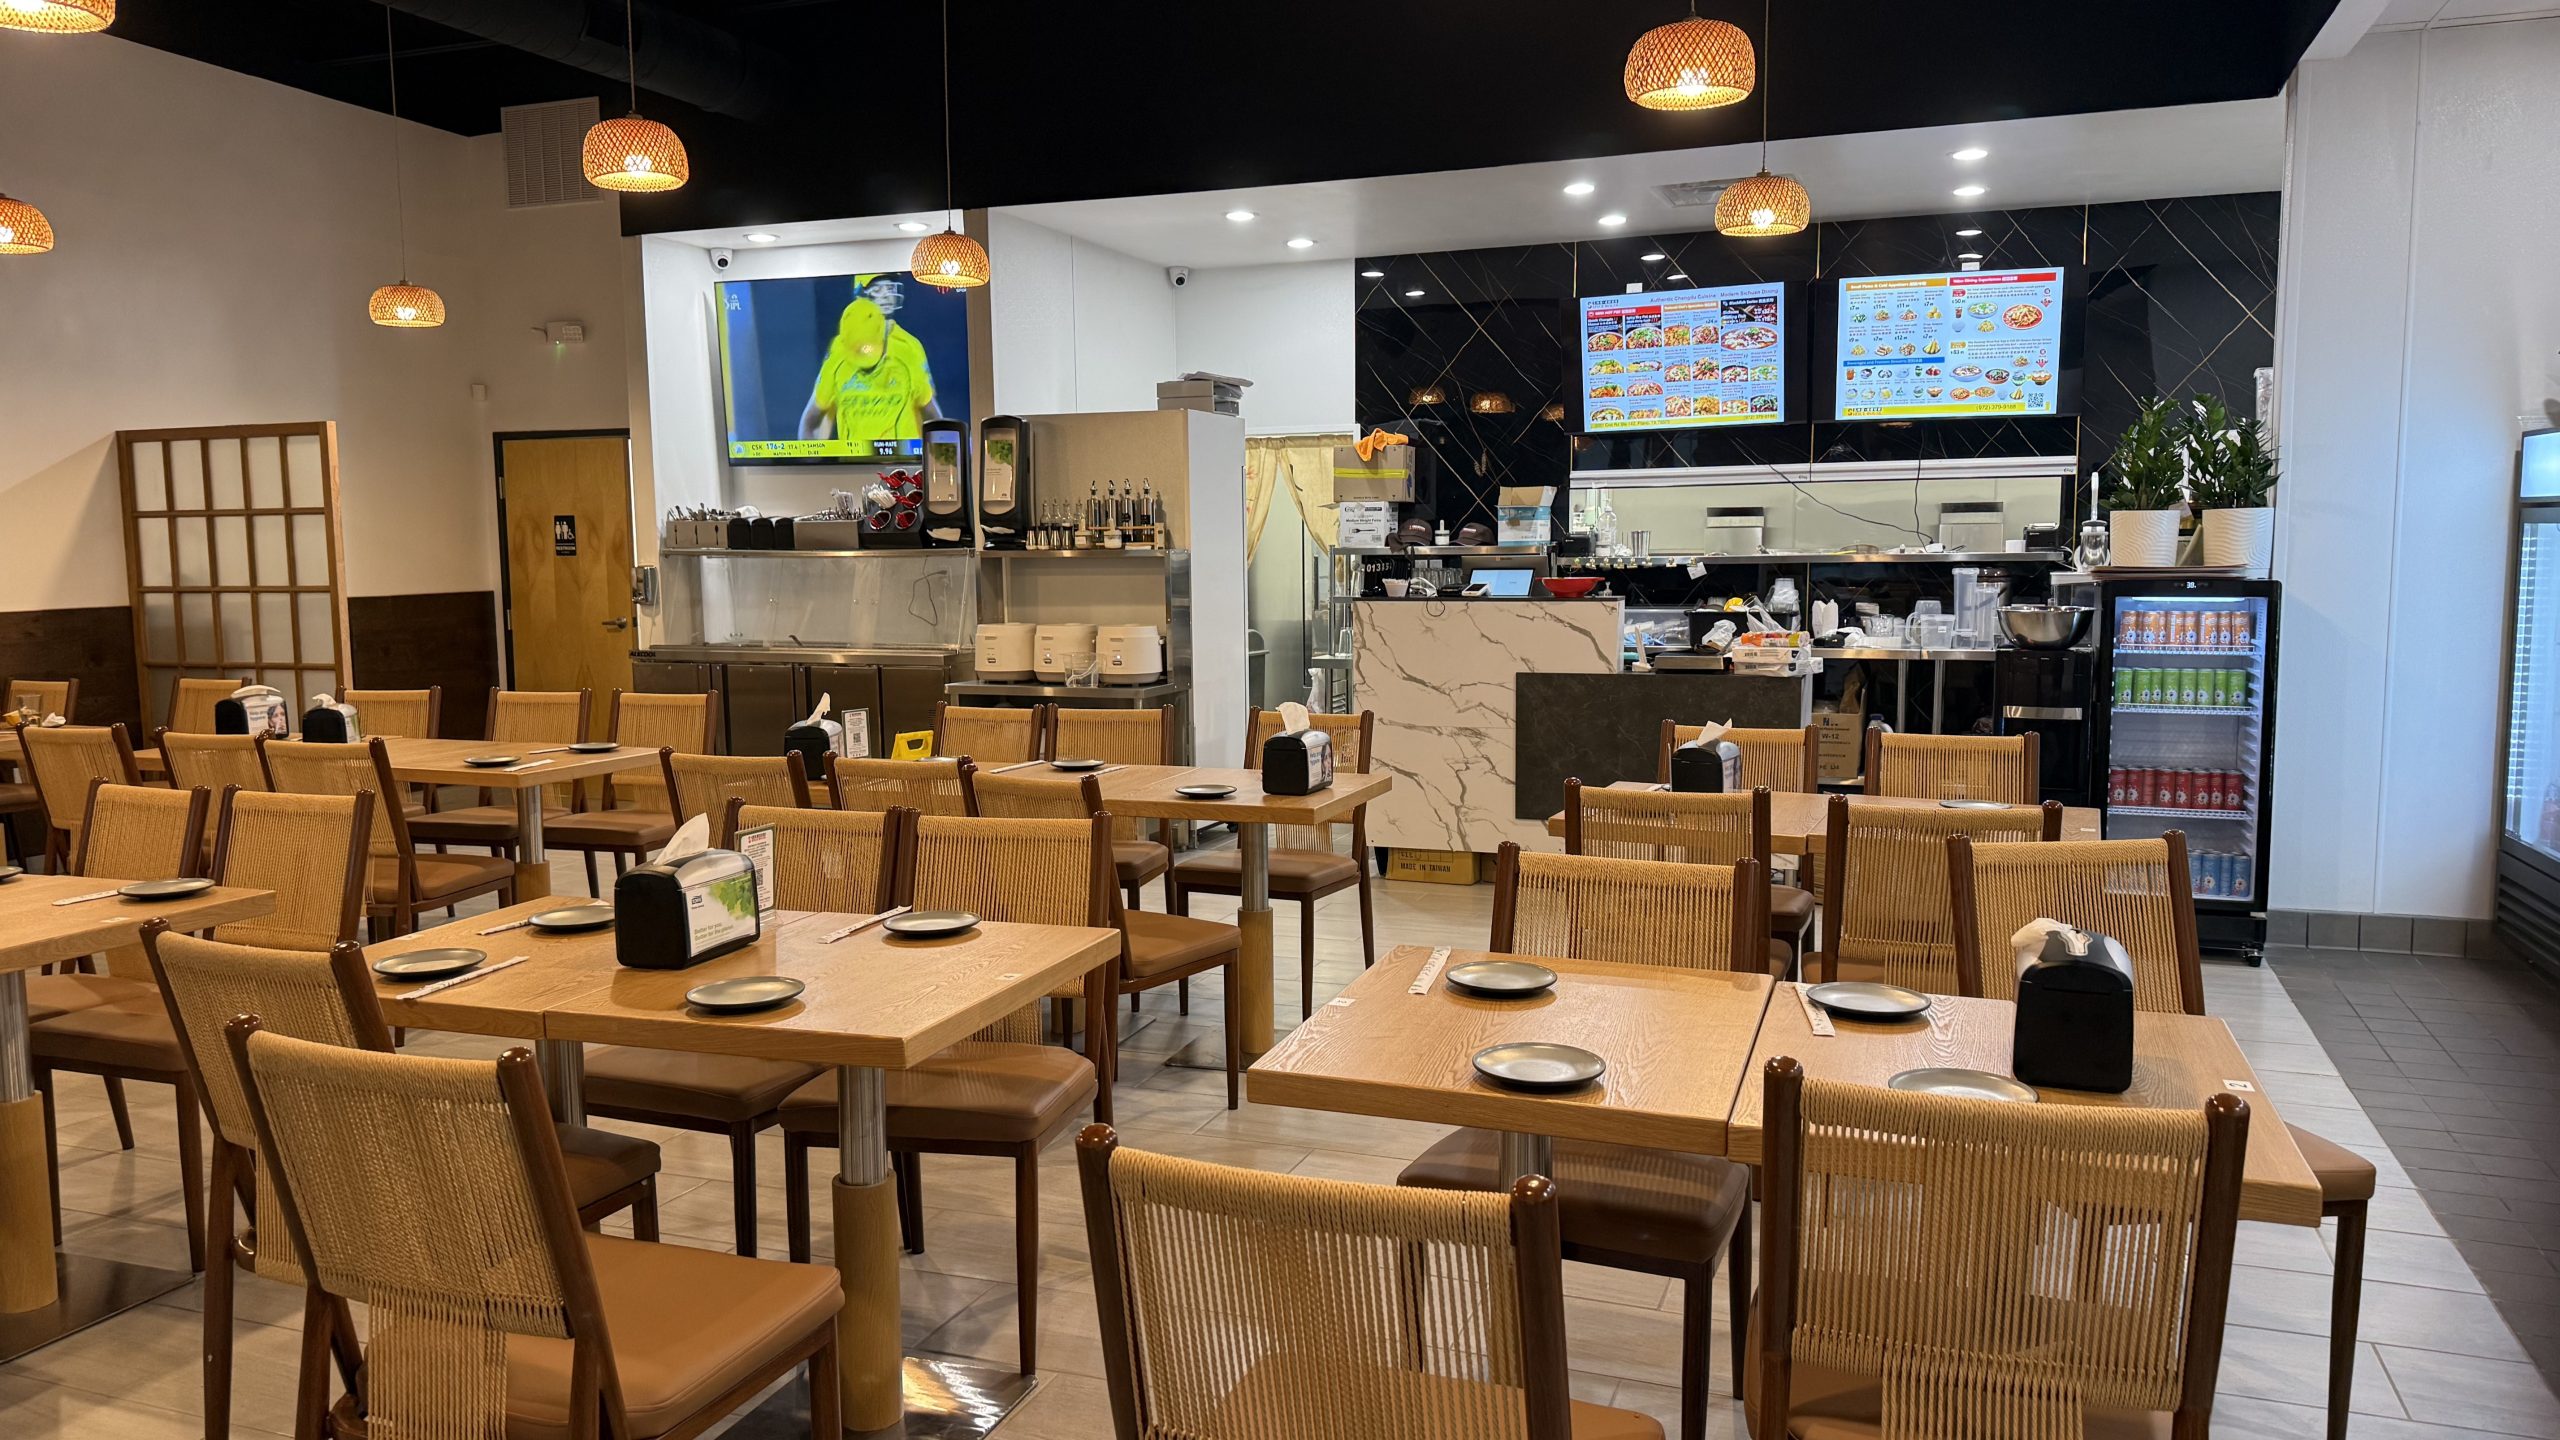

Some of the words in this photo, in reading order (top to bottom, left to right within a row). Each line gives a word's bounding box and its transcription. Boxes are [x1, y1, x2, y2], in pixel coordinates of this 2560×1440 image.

[766, 442, 785, 450] 176-2
[1400, 862, 1417, 871] MADE
[1419, 863, 1426, 871] IN
[1429, 864, 1451, 873] TAIWAN
[694, 926, 708, 935] Better
